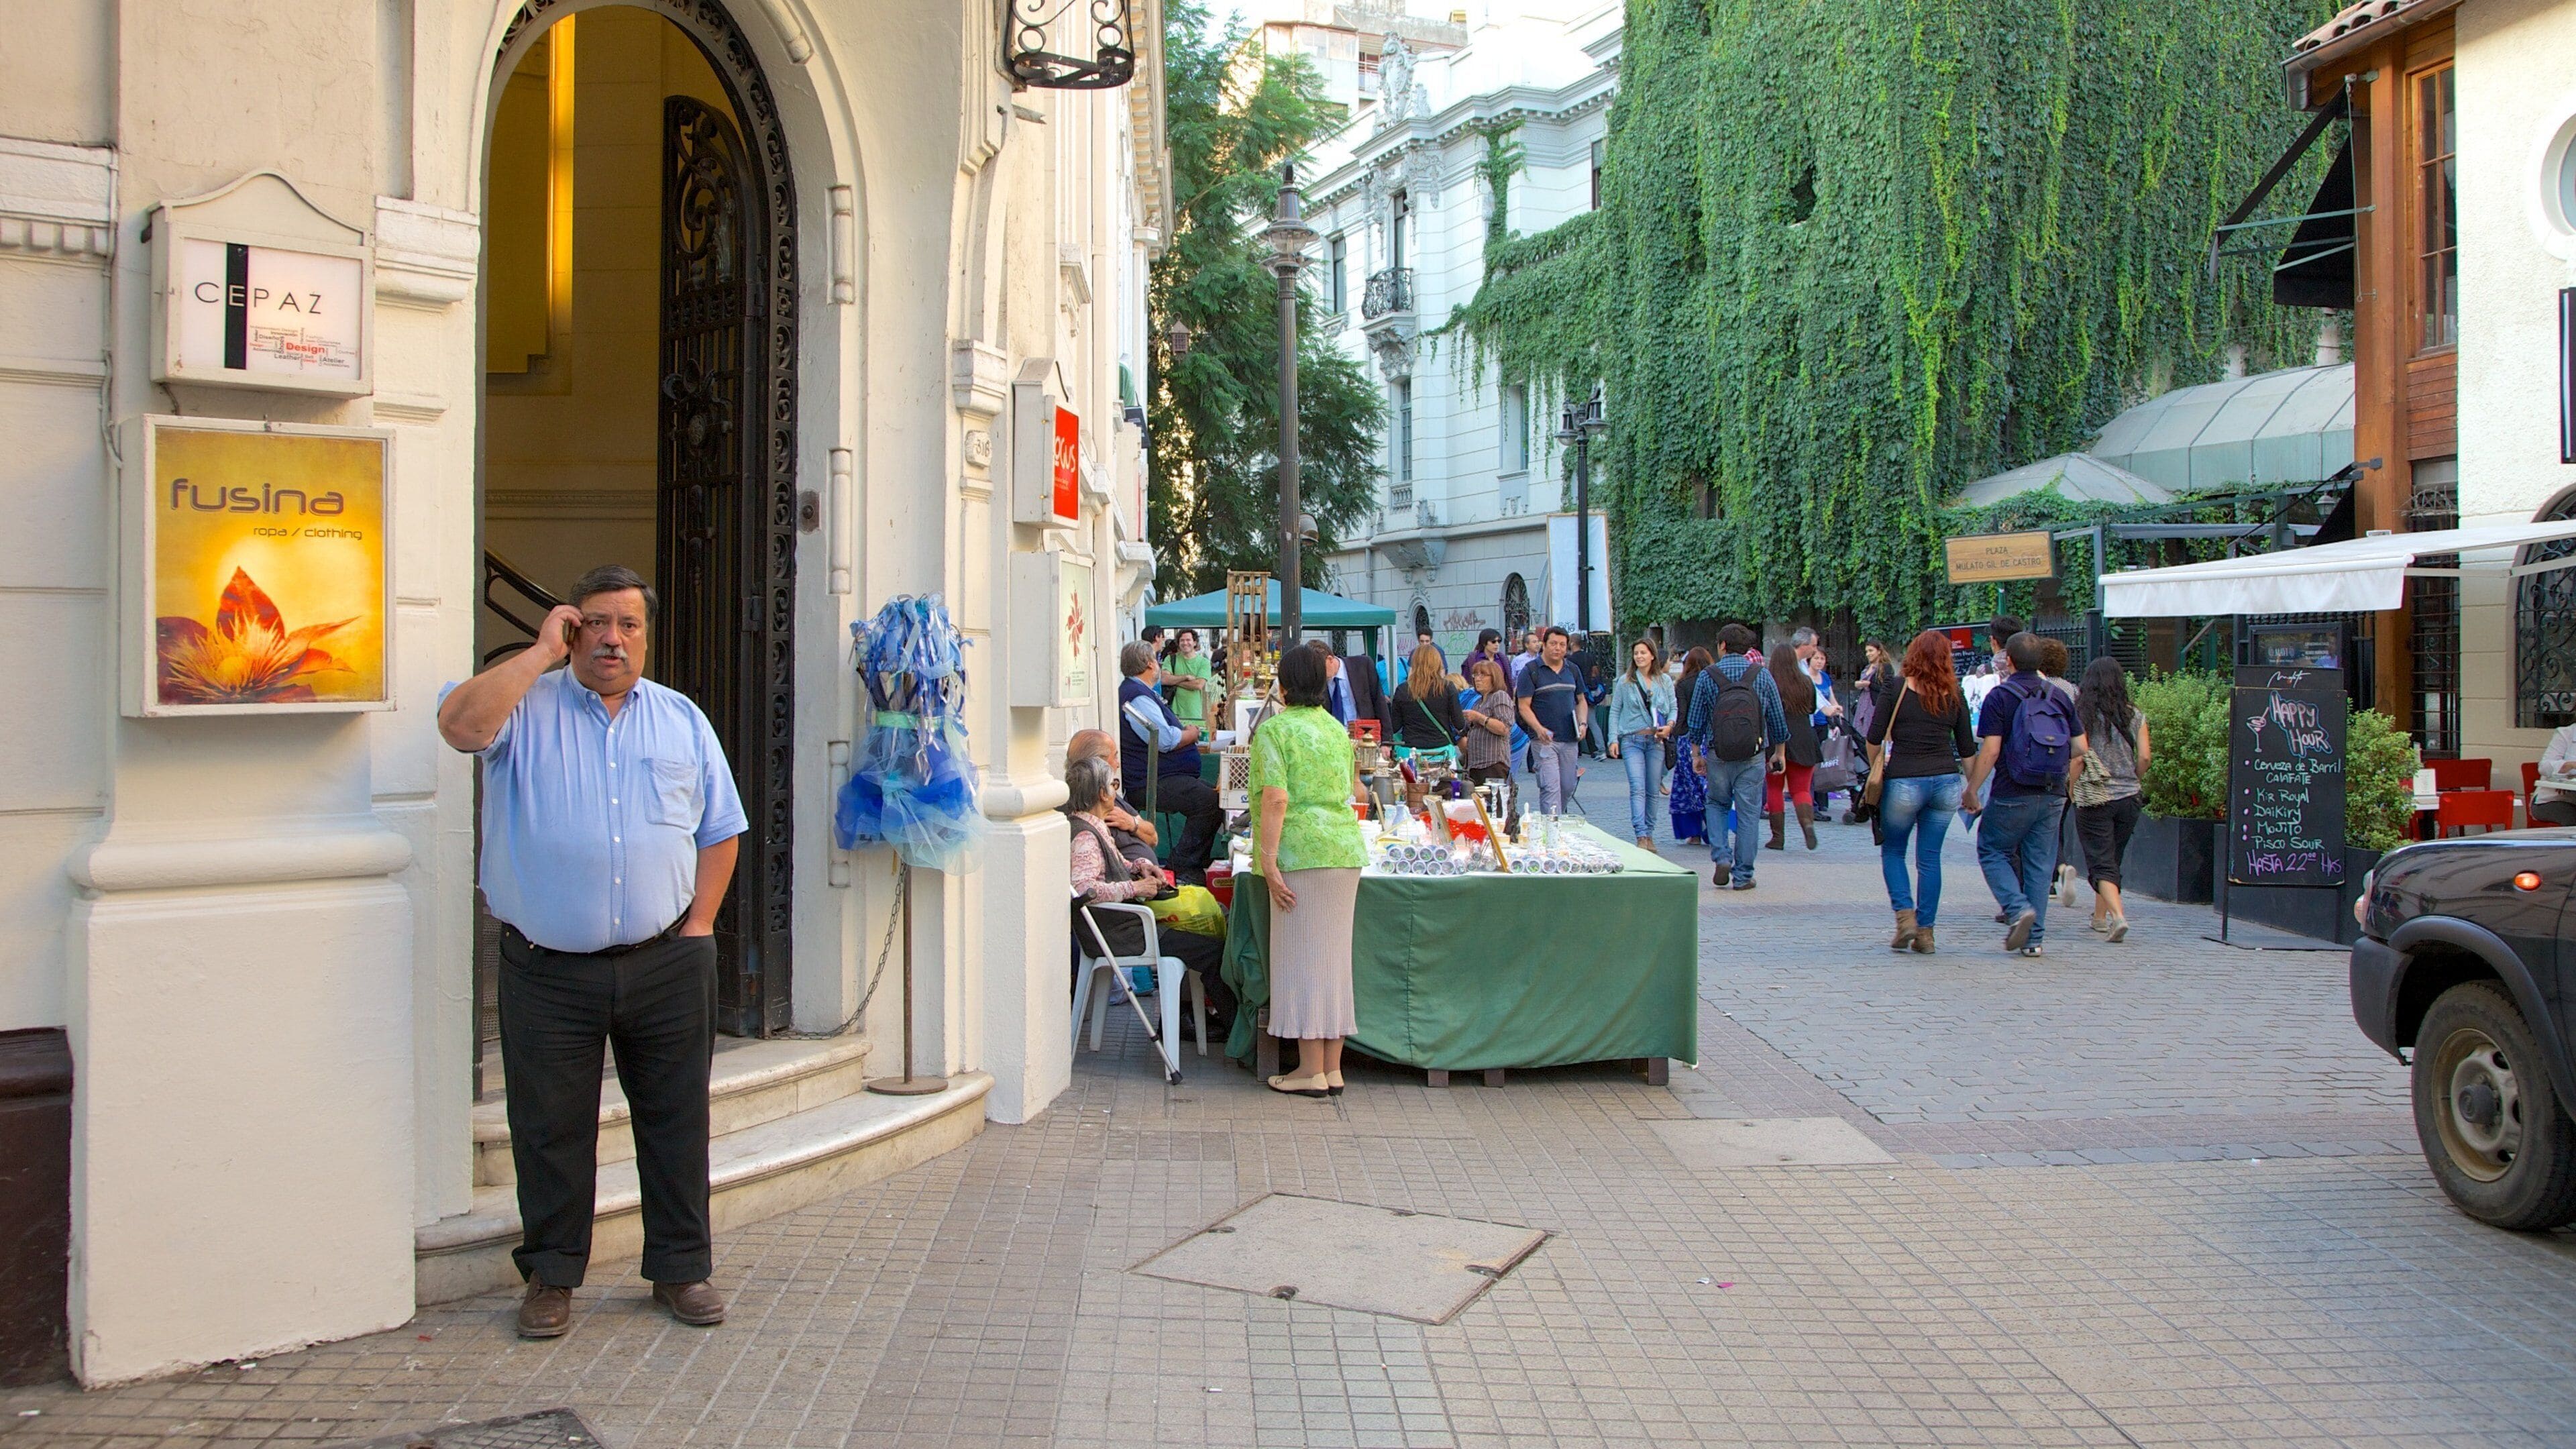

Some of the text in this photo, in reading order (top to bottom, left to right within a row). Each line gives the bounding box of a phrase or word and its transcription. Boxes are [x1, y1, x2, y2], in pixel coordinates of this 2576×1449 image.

[195, 282, 321, 314] CEPAZ
[286, 342, 325, 355] Design
[170, 478, 344, 515] fusina
[253, 527, 287, 537] ropa
[304, 529, 363, 540] clothing
[1986, 547, 2008, 555] PLAZA
[1955, 561, 1984, 570] MULATO
[2012, 557, 2041, 566] CASTRO
[2271, 694, 2315, 728] HAPPY
[2289, 729, 2328, 756] HOUR
[2295, 758, 2306, 771] de
[2246, 849, 2284, 877] HASTA
